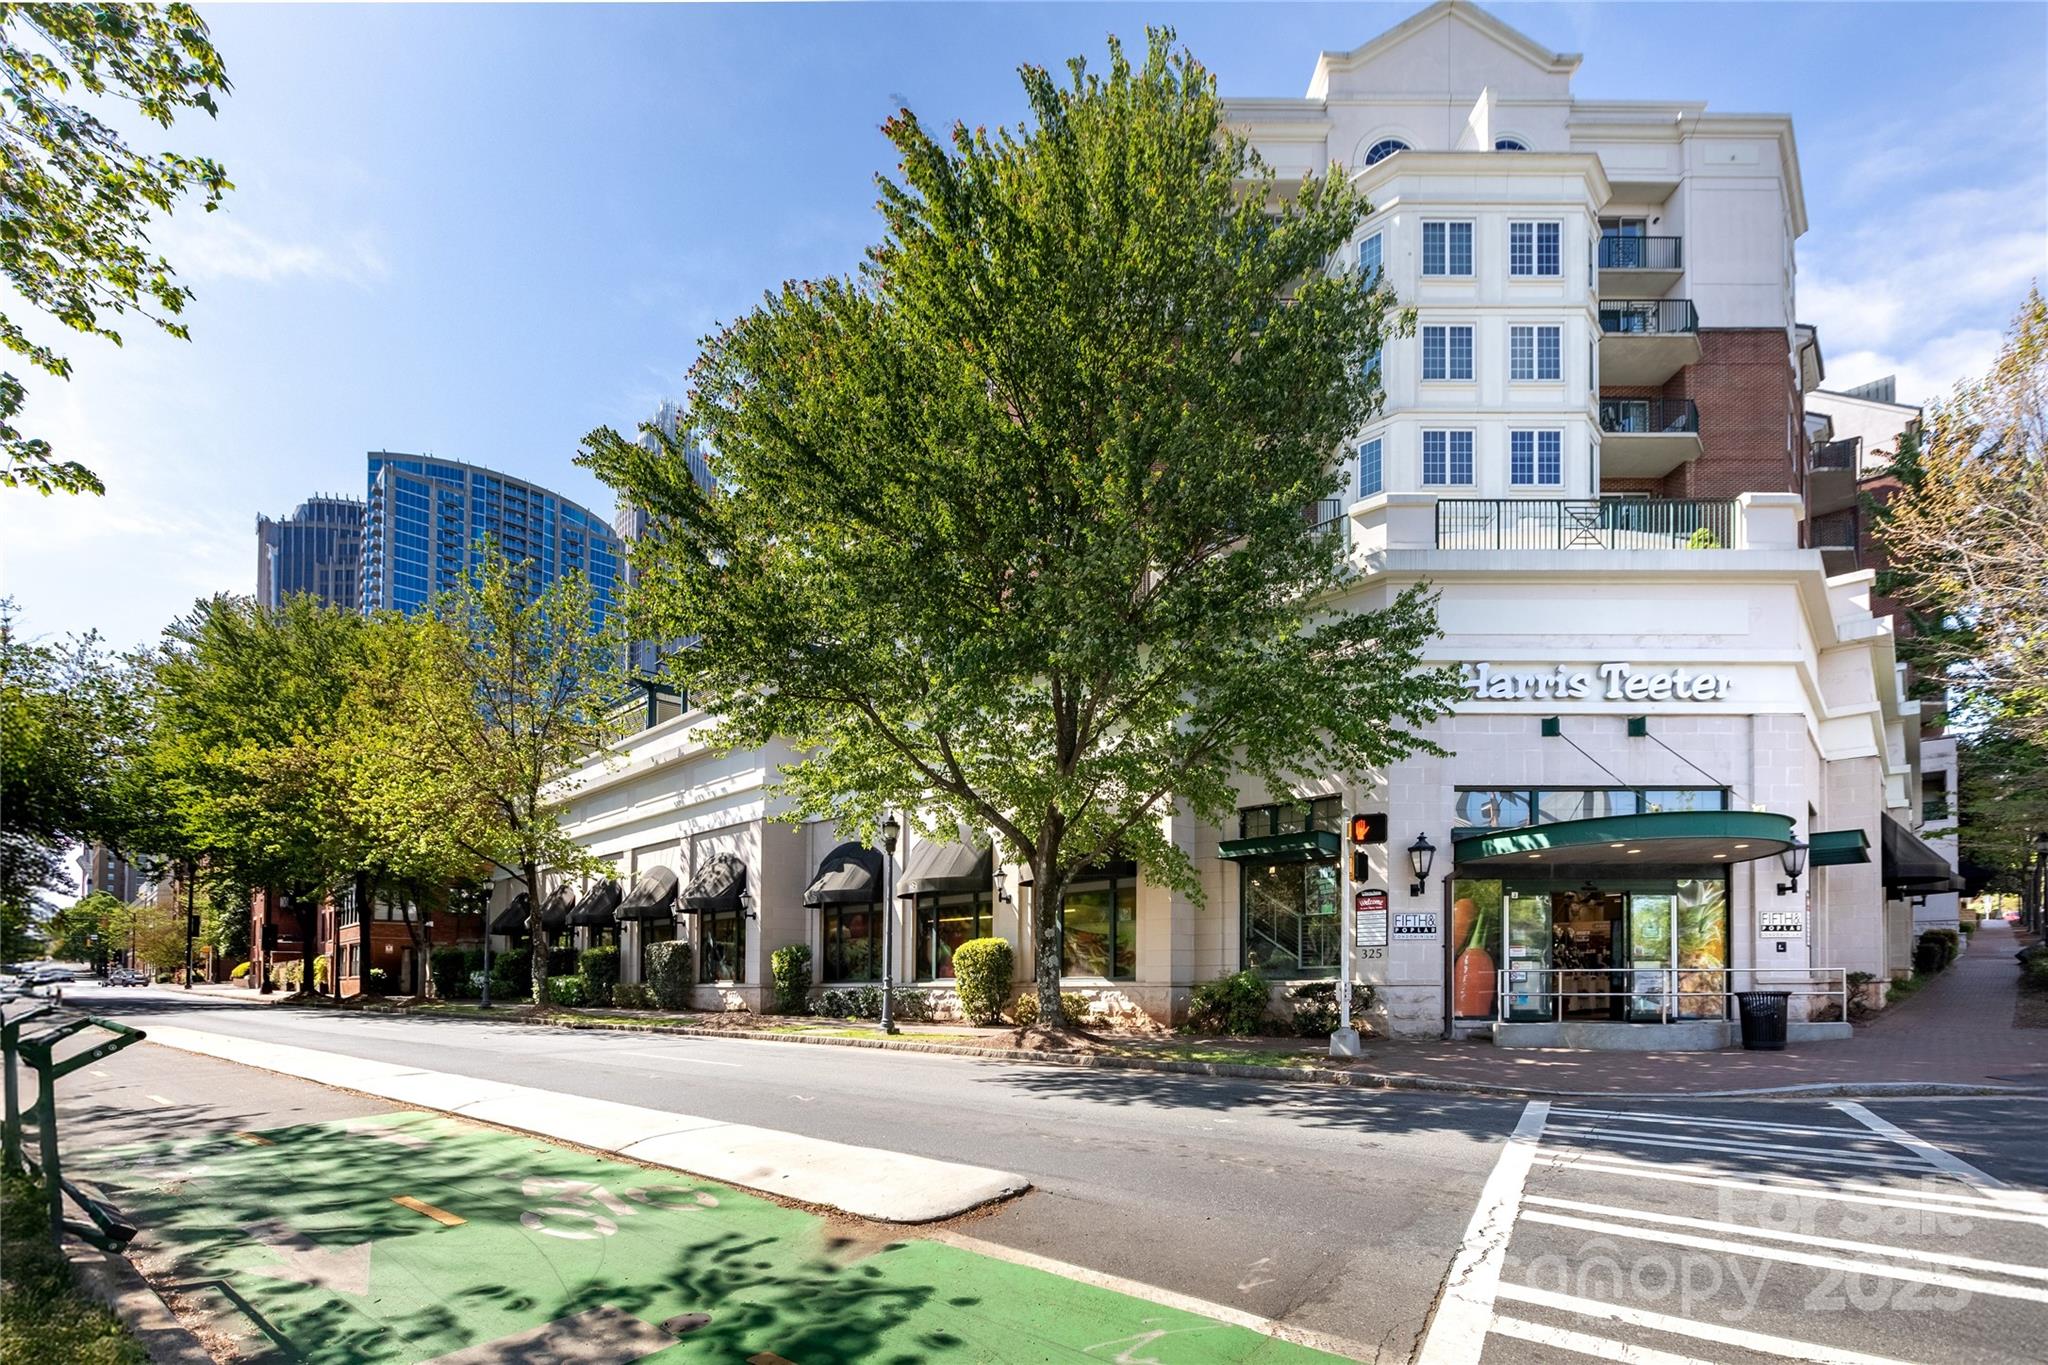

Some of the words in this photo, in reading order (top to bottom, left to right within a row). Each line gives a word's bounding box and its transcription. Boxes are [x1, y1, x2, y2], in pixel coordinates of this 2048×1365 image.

[1459, 662, 1592, 699] Harris
[1597, 661, 1735, 700] Teeter
[1361, 948, 1382, 959] 325
